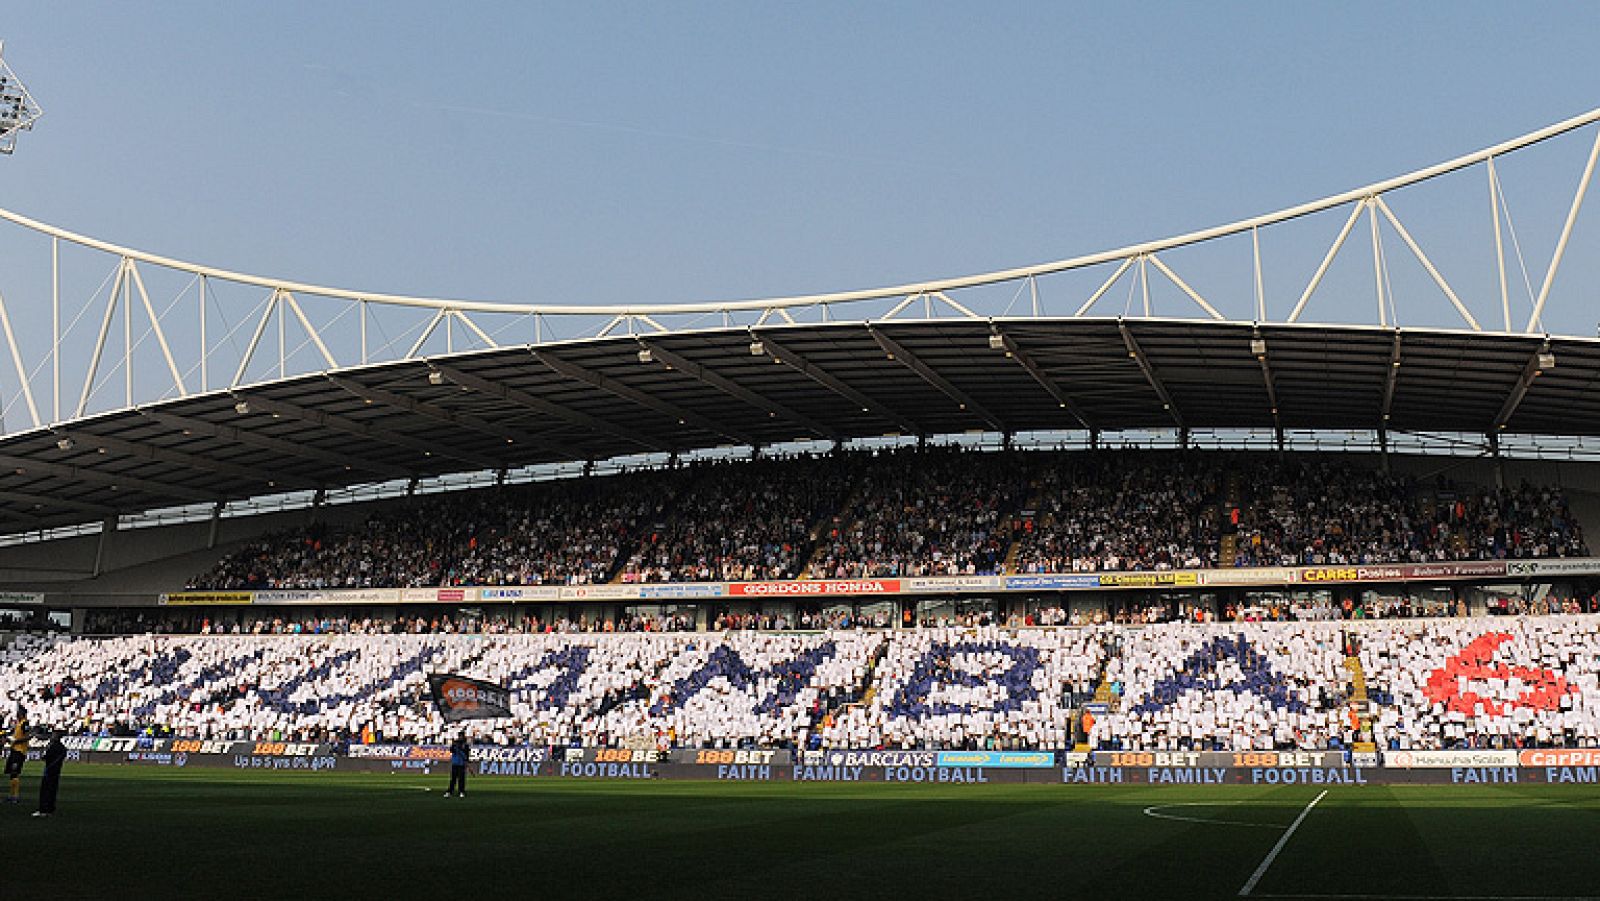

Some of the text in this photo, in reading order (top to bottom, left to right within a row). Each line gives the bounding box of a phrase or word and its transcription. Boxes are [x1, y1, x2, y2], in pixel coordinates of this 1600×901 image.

[1303, 568, 1356, 581] CARRS
[743, 582, 884, 593] GORDONS HONDA
[234, 755, 248, 768] Up
[468, 747, 544, 762] BARCLAYS
[695, 750, 774, 765] 188BET
[845, 751, 932, 766] BARCLAYS
[1111, 753, 1199, 767] 188BET
[1232, 752, 1325, 767] 188BET
[480, 762, 651, 777] FAMILY FOOTBALL
[717, 765, 988, 782] FAITH FAMILY FOOTBALL
[1063, 767, 1368, 783] FAITH FAMILY FOOTBALL
[1451, 767, 1600, 783] FAITH FAM
